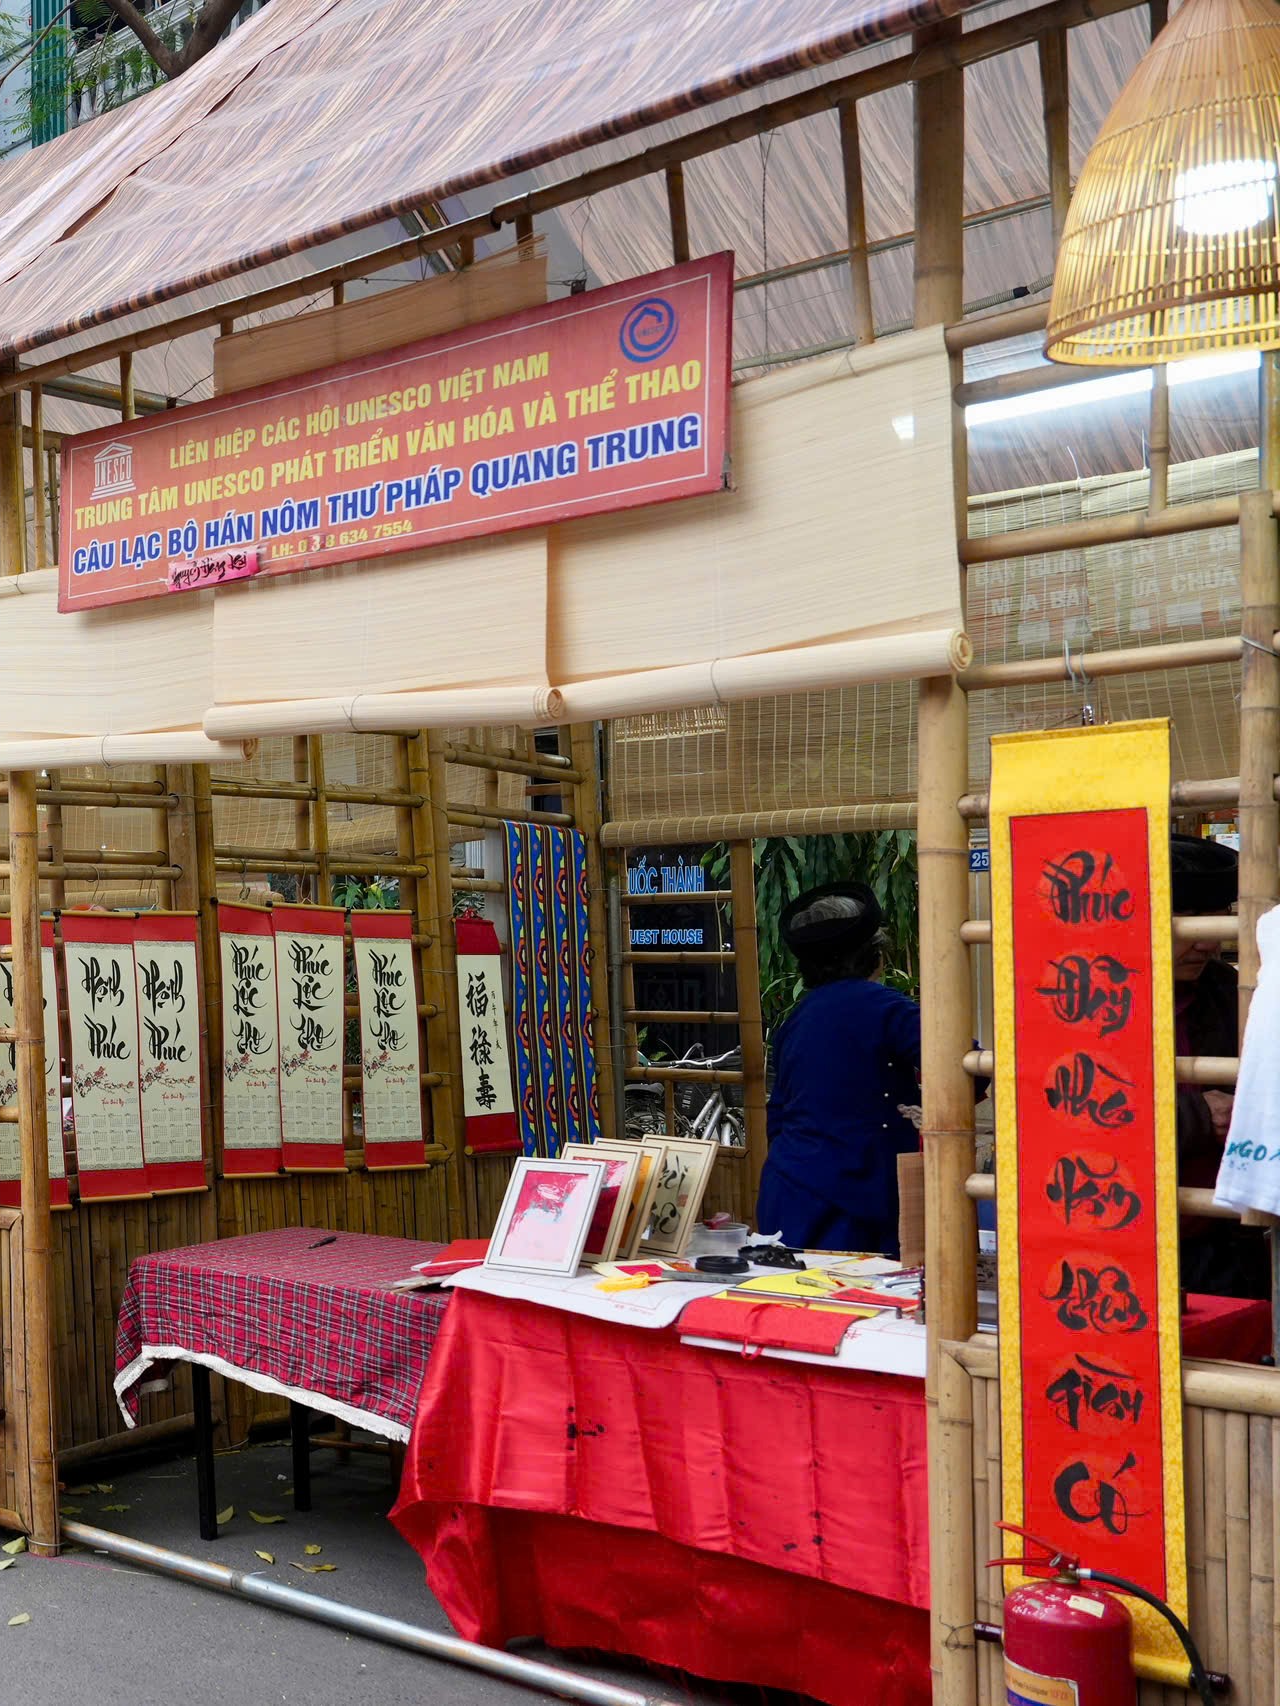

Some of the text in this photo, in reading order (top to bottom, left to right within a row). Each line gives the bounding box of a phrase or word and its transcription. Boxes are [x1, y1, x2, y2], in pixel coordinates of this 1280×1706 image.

[170, 351, 549, 470] LIÊN HIỆP CÁC HỘI UNESCO VIỆT NAM
[74, 359, 702, 531] TRUNG TÂM UNESCO PHÁT TRIỂN VĂN HÓA VÀ THỂ THAO
[94, 454, 133, 488] UNESCO
[73, 412, 701, 576] CÂU LẠC BỘ HÁN NÔM THƯ PHÁP QUANG TRUNG
[272, 543, 294, 559] LH:
[339, 528, 369, 546] 634
[373, 519, 414, 538] 7554
[628, 855, 705, 895] UỐC THÀNH
[629, 928, 703, 945] UEST HOUSE
[230, 939, 271, 981] Phúc
[287, 939, 333, 976] Phúc
[368, 949, 407, 987] Phúc
